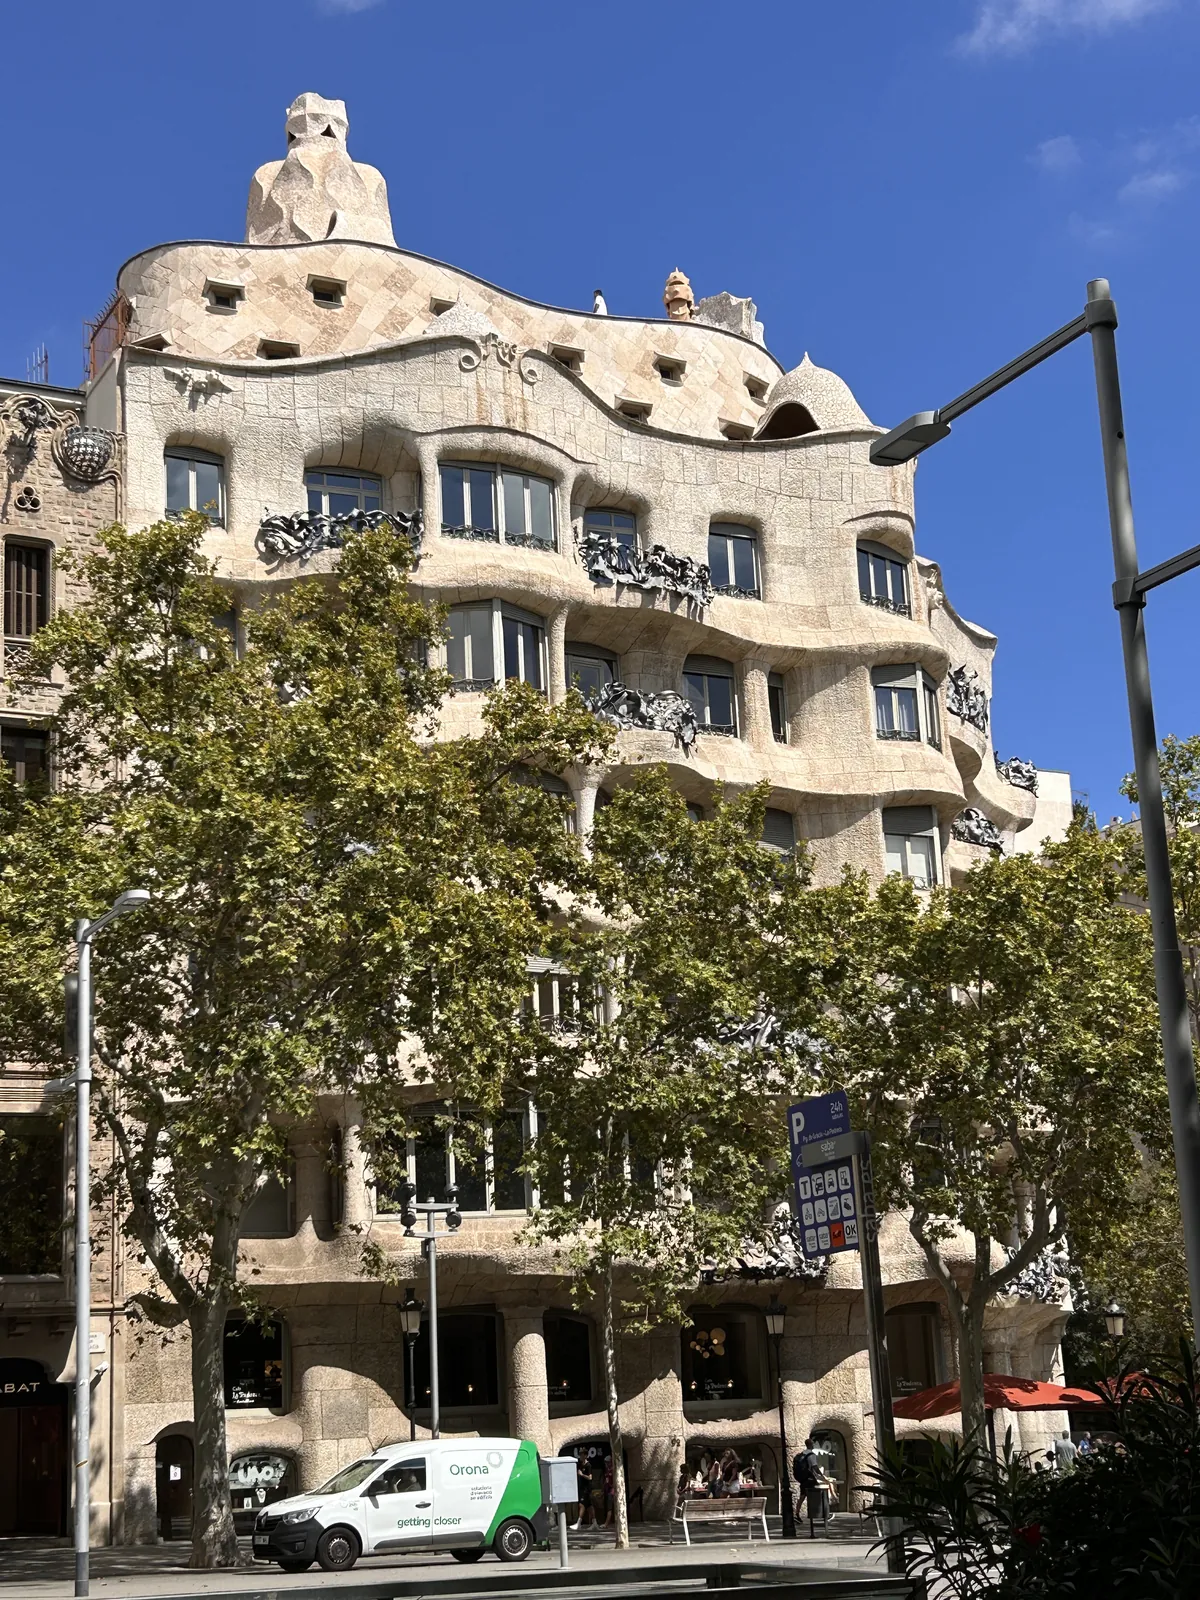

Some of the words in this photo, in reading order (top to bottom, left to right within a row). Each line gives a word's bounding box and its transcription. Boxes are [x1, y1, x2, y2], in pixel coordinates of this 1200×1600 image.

[830, 1101, 843, 1114] 24h
[791, 1111, 805, 1145] P
[845, 1224, 857, 1236] OK
[449, 1464, 489, 1476] Orona
[397, 1516, 431, 1529] getting
[434, 1515, 462, 1526] closer
